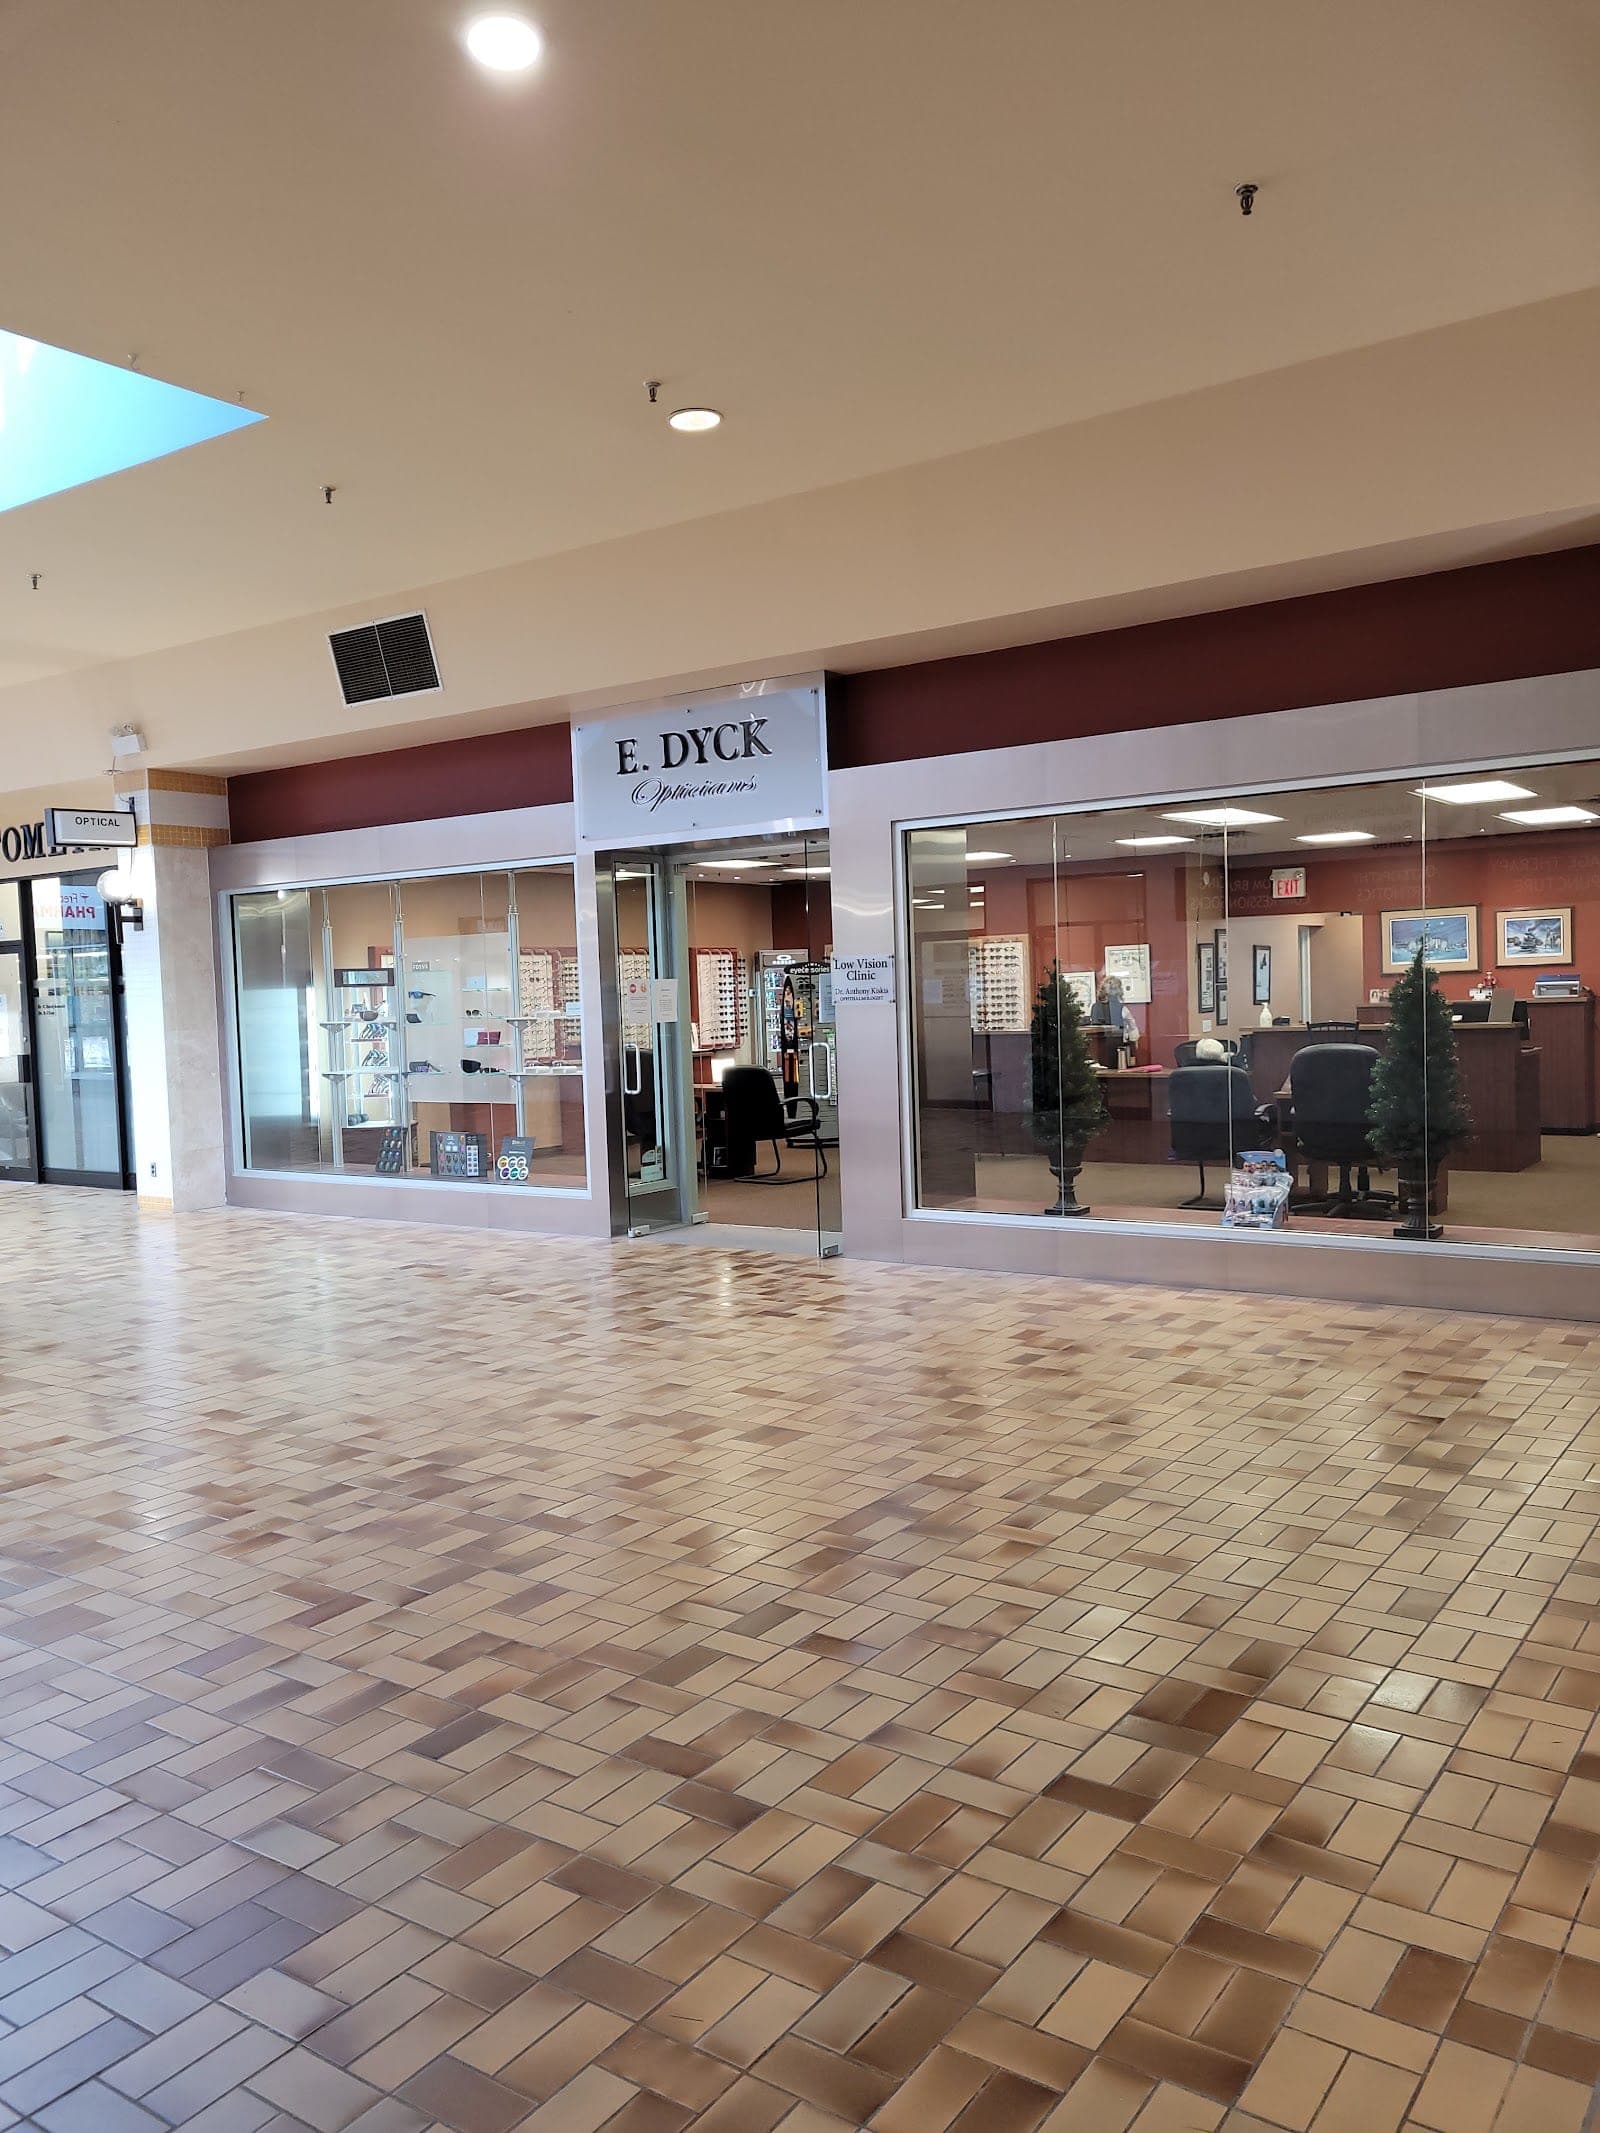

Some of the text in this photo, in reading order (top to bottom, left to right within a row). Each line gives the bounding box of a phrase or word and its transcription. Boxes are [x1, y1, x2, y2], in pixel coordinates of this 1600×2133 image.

[615, 718, 773, 775] E. DYCK
[631, 775, 757, 812] Opticians
[75, 816, 120, 827] OPTICAL
[1277, 879, 1298, 896] EXIT
[834, 960, 854, 970] Low
[856, 958, 888, 969] Vision
[846, 970, 876, 981] Clinic
